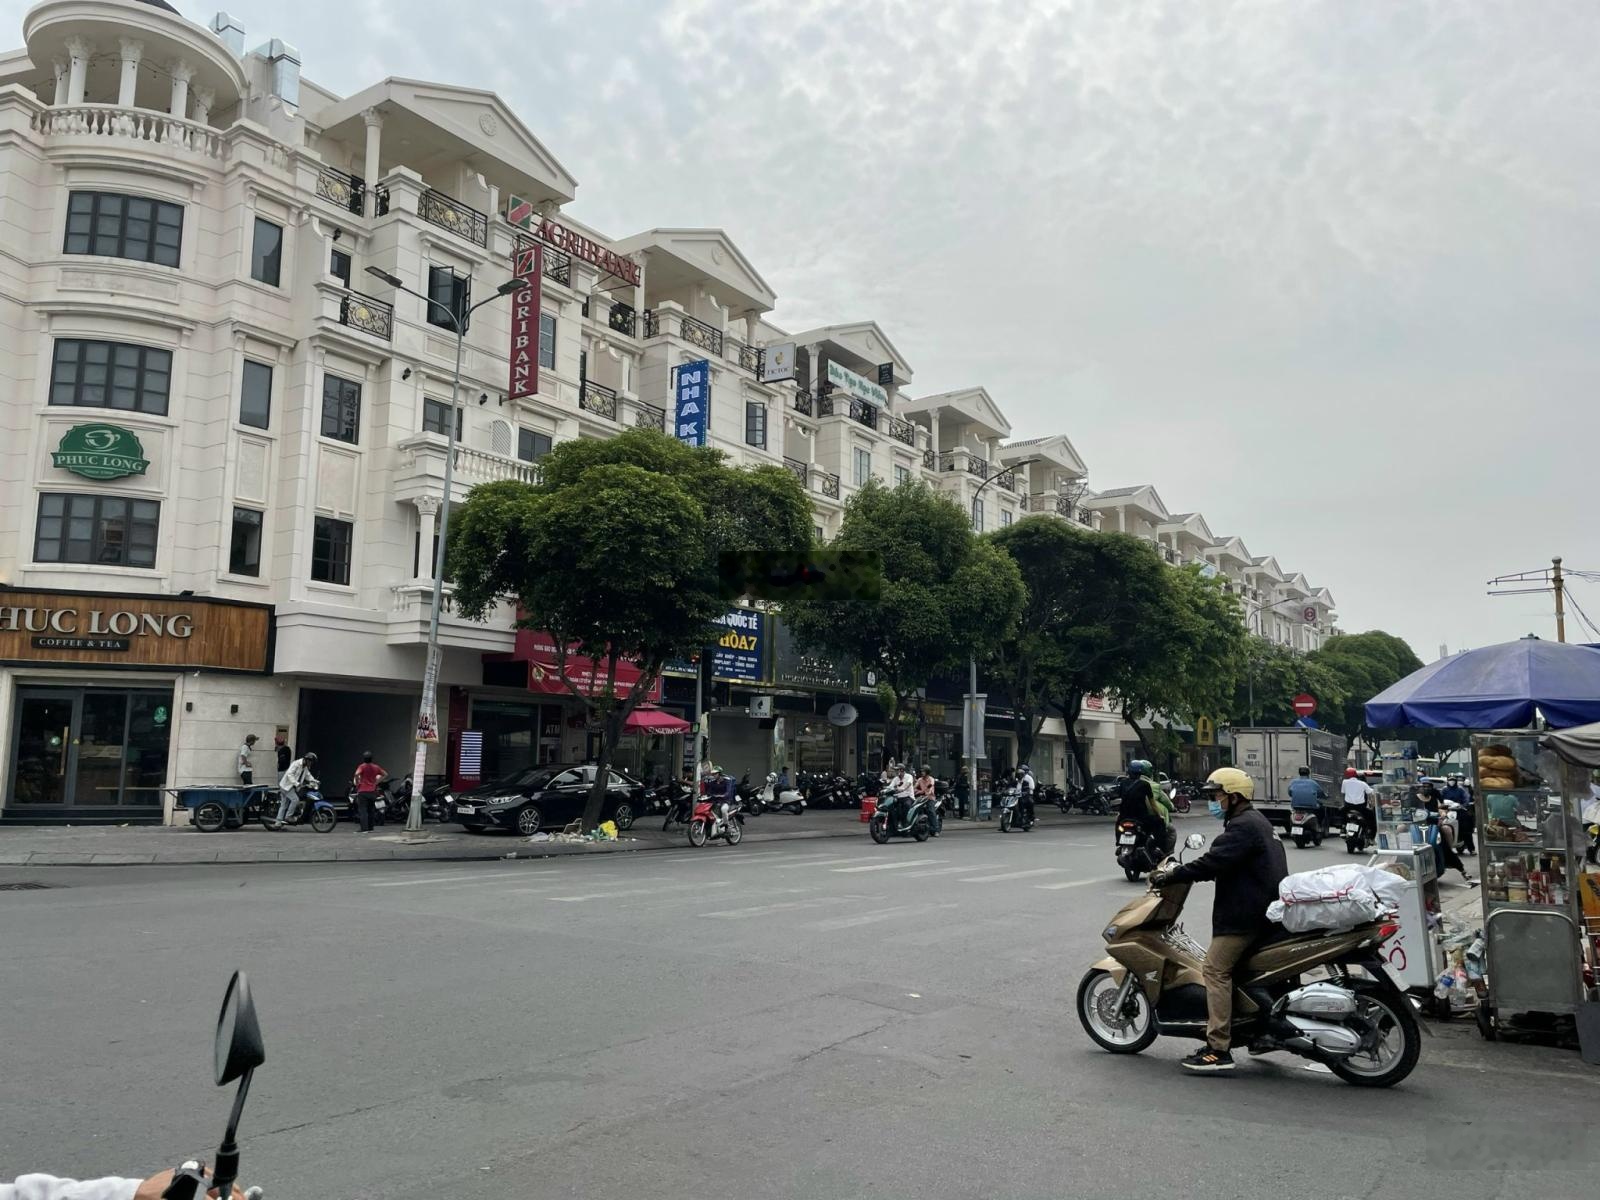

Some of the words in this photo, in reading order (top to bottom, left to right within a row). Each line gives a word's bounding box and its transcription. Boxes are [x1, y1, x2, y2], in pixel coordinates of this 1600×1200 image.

[681, 370, 701, 417] NHA
[57, 455, 98, 465] PHUC
[103, 457, 142, 471] LONG
[88, 610, 194, 639] LONG
[748, 613, 758, 630] TẾ
[39, 638, 82, 647] COFFEE
[100, 640, 121, 648] TEA
[545, 724, 560, 735] ATM
